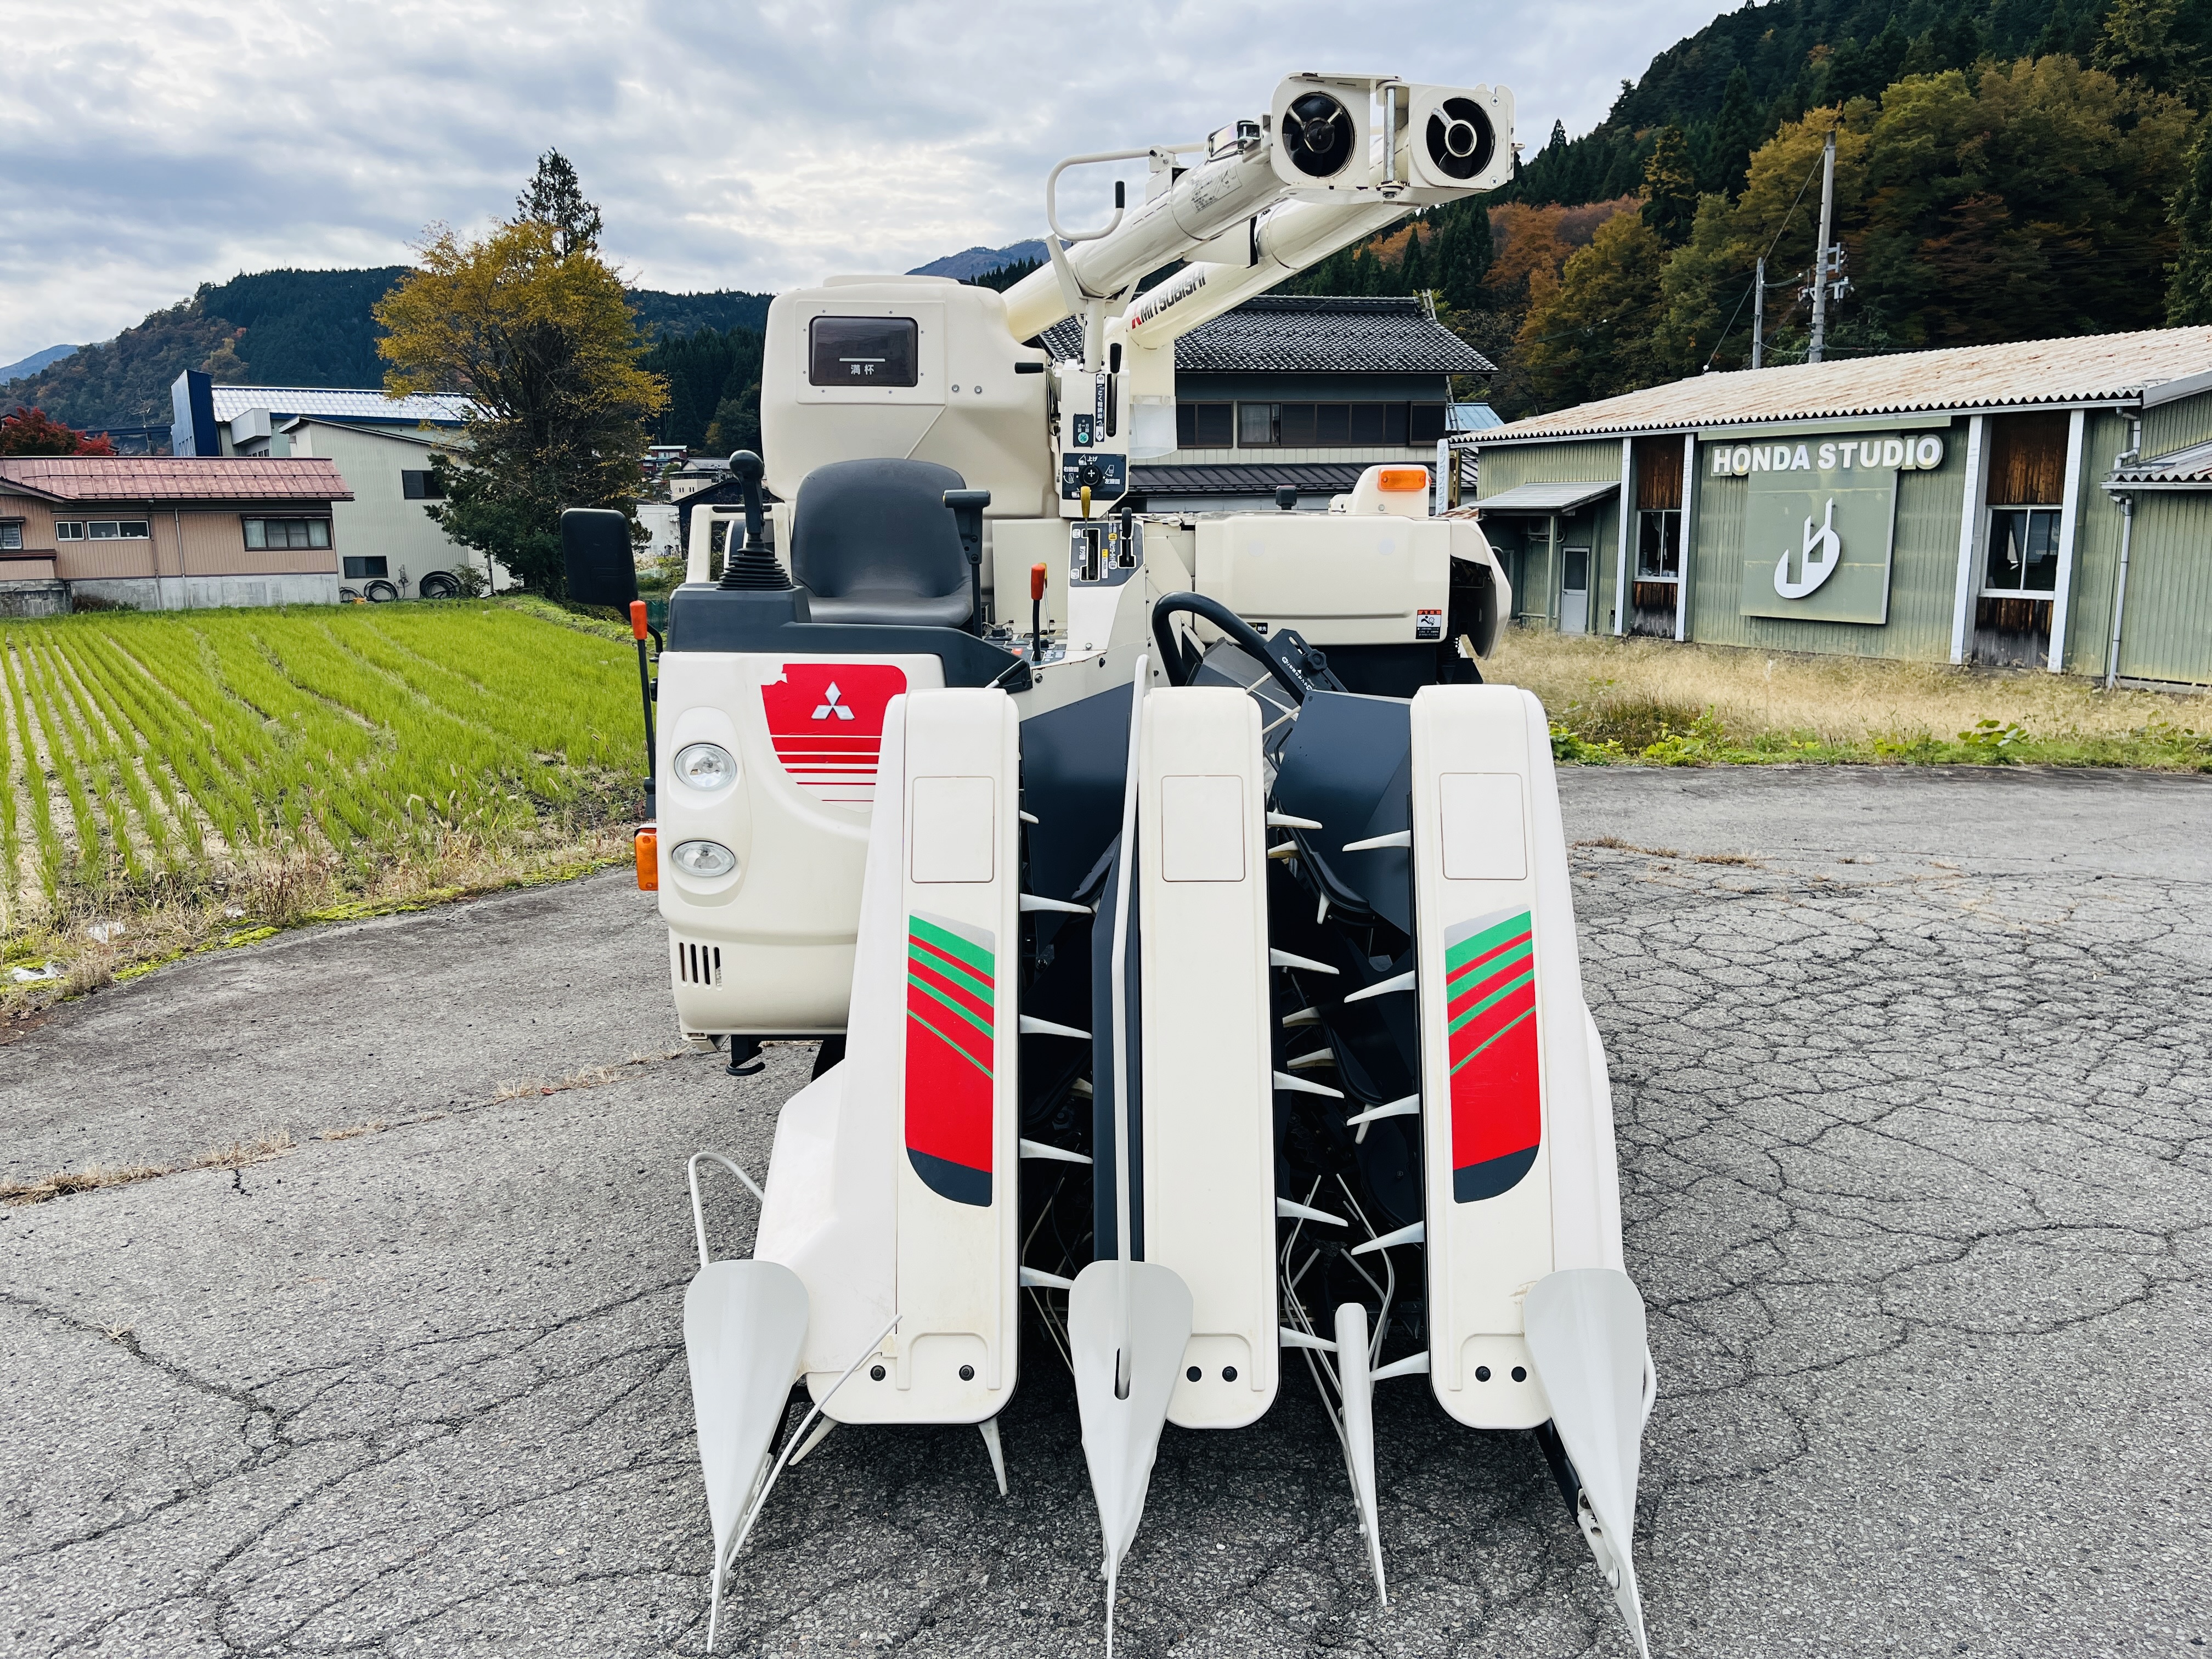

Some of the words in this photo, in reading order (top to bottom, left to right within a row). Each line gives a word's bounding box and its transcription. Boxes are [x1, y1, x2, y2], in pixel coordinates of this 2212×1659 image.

[1141, 266, 1206, 323] MITSUBISHI
[850, 364, 874, 375] 満杯
[1712, 443, 1810, 475] HONDA
[1817, 437, 1942, 470] STUDIO
